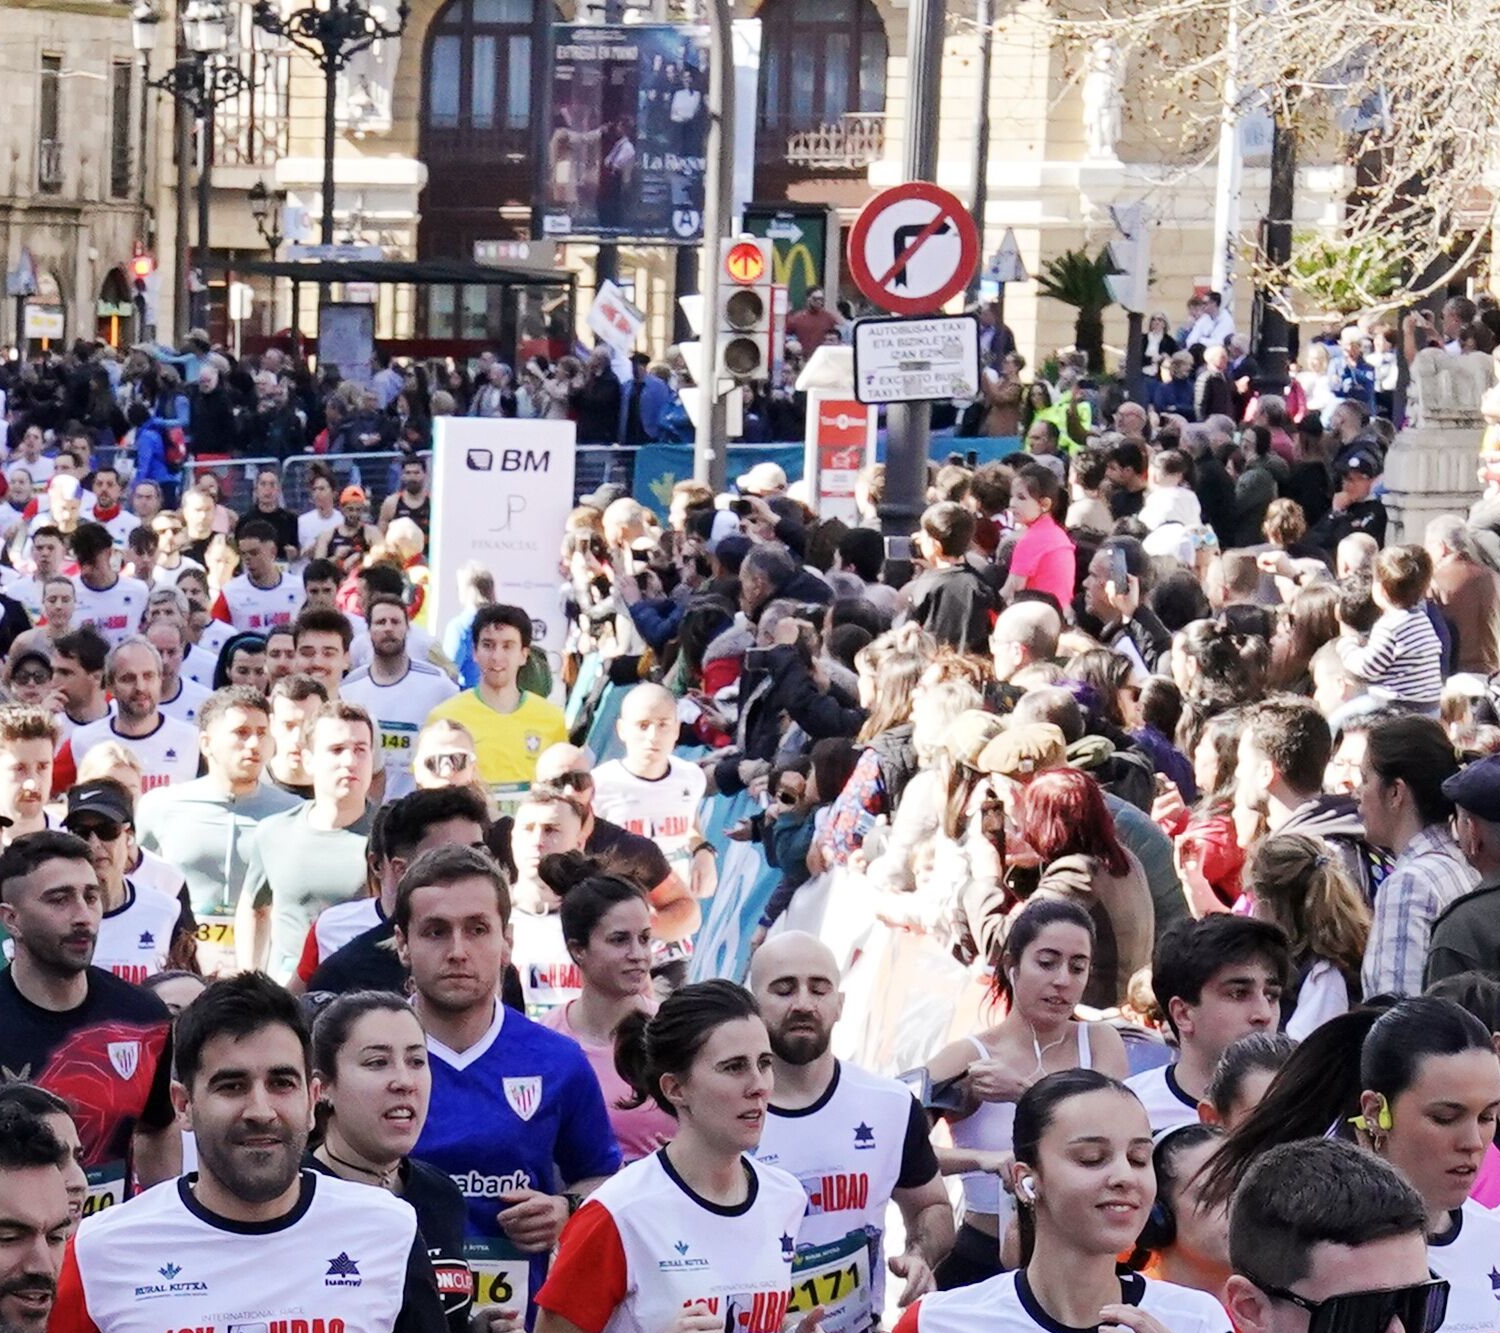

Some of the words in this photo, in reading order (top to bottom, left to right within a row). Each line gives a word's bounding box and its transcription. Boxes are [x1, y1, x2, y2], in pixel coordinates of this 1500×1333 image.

[500, 449, 551, 473] BM
[135, 1283, 173, 1297] RURAL
[175, 1280, 208, 1294] KUTXA
